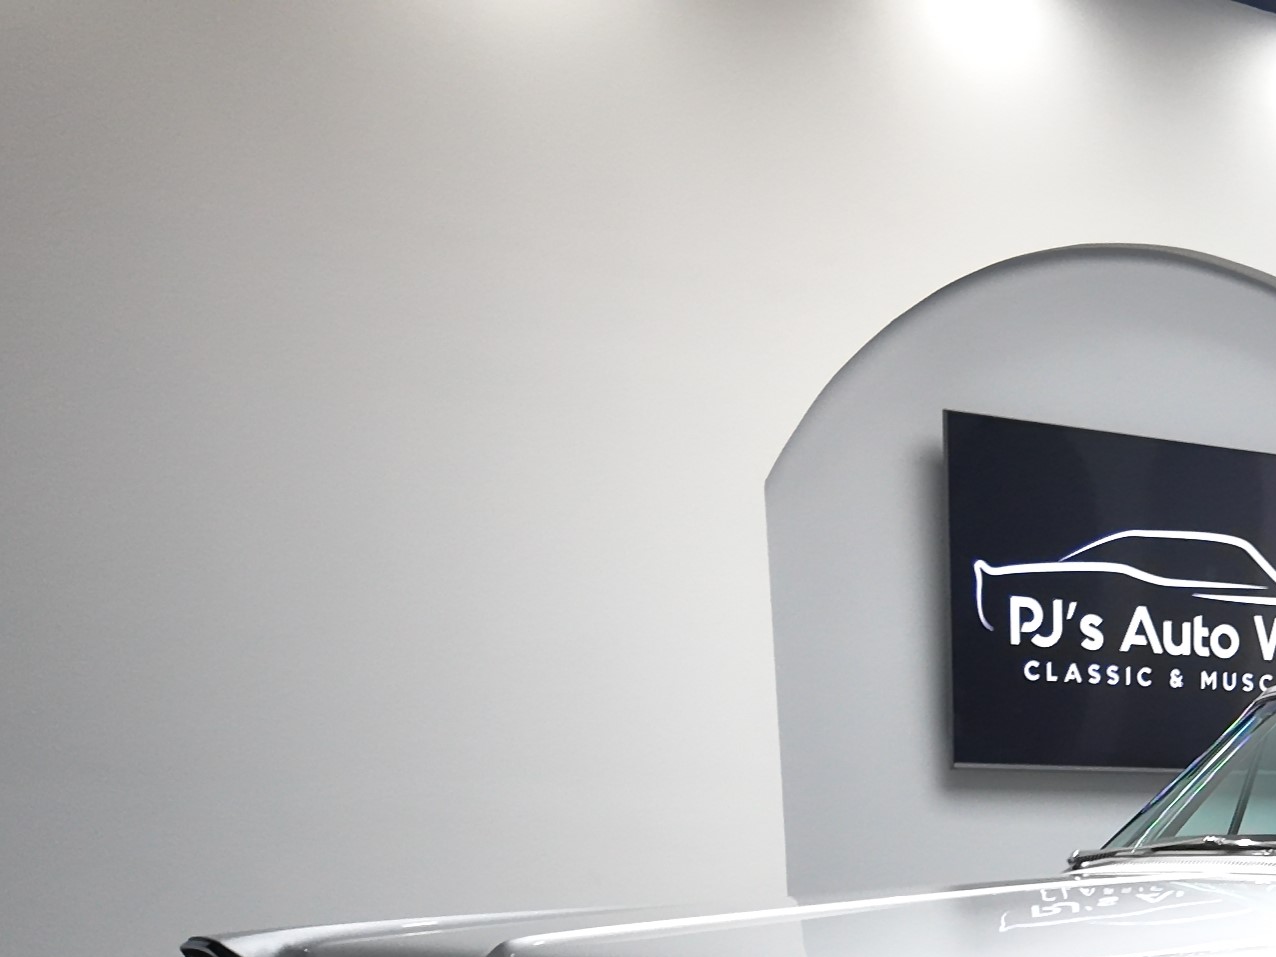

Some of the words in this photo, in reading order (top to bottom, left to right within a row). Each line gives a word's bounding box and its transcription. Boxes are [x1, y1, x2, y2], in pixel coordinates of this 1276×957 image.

[1009, 595, 1105, 651] PJ's
[1119, 605, 1240, 659] Auto
[1023, 659, 1153, 687] CLASSIC
[1169, 668, 1184, 689] &
